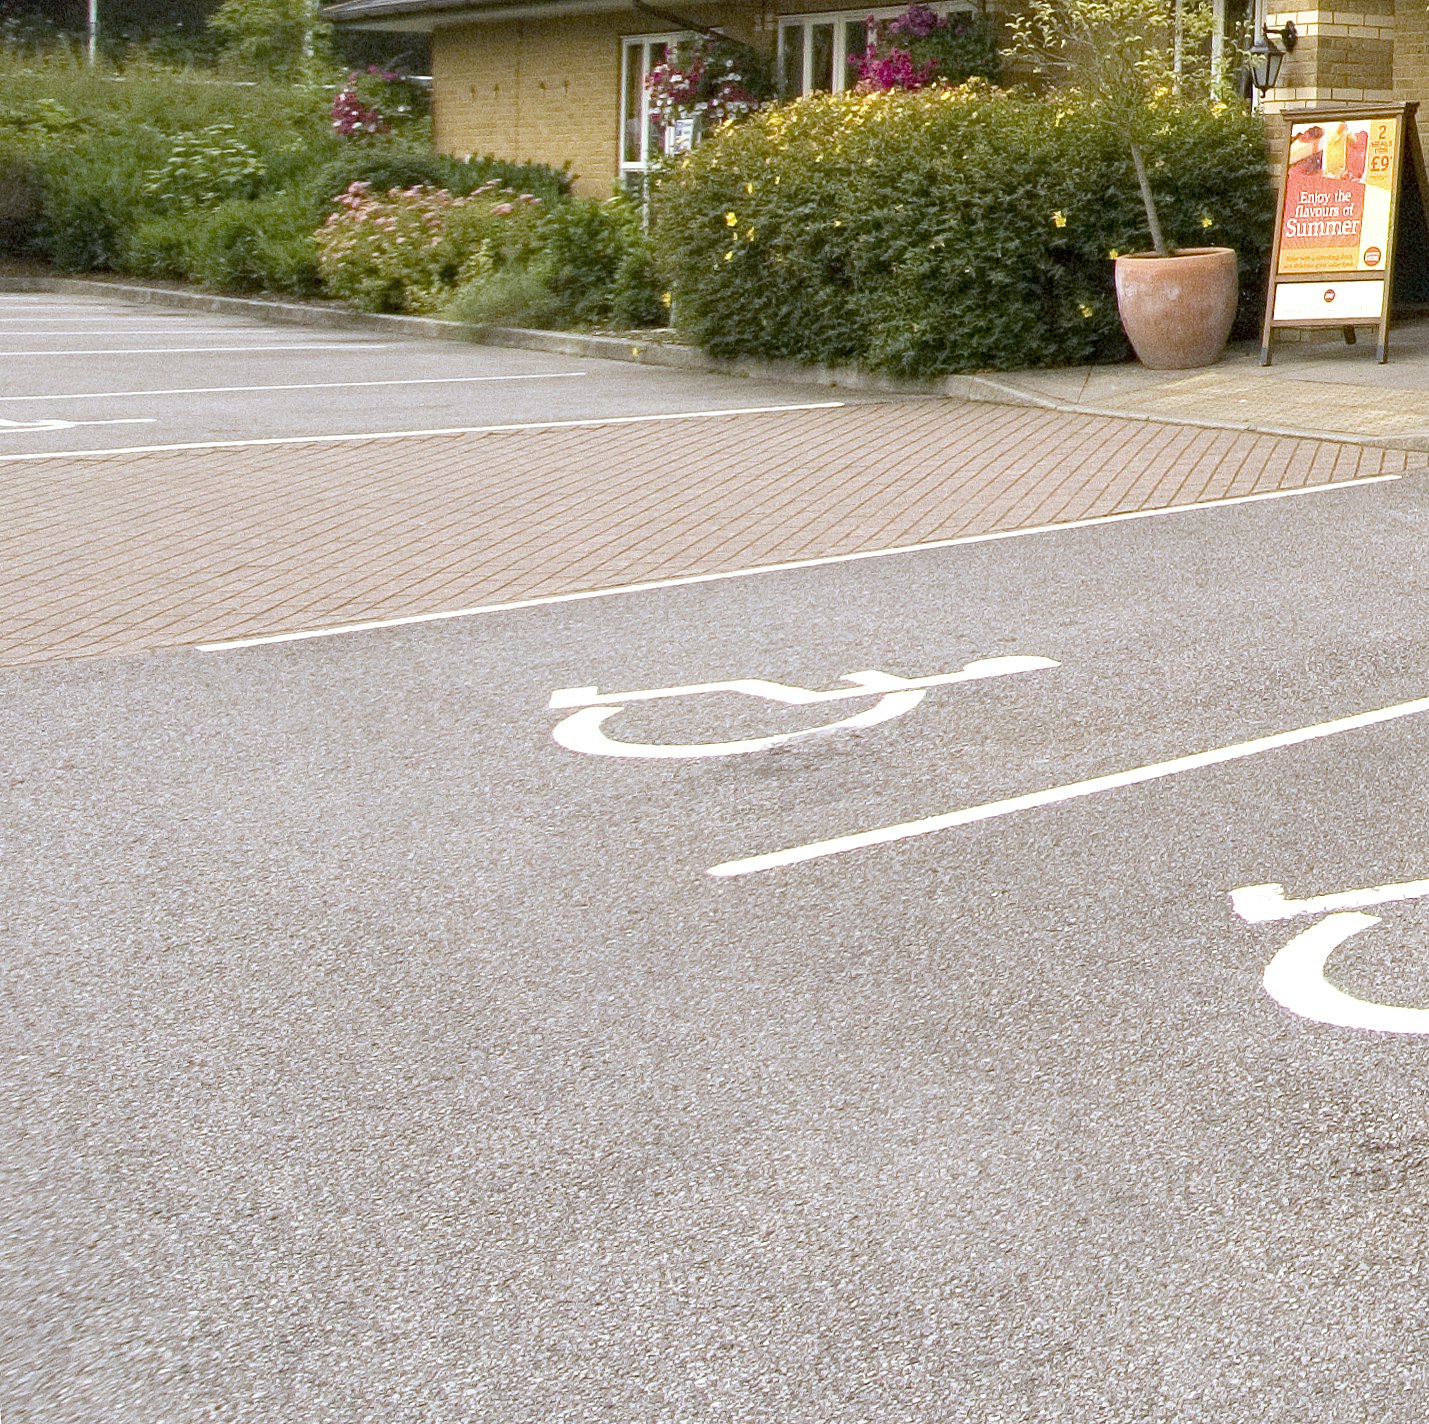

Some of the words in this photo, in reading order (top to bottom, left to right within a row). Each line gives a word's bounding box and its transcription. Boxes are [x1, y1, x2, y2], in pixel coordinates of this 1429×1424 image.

[1378, 124, 1387, 140] 2
[1298, 190, 1331, 207] Enjoy
[1334, 188, 1352, 203] the
[1294, 204, 1340, 218] flavours
[1342, 202, 1355, 216] of
[1284, 217, 1361, 238] Summer
